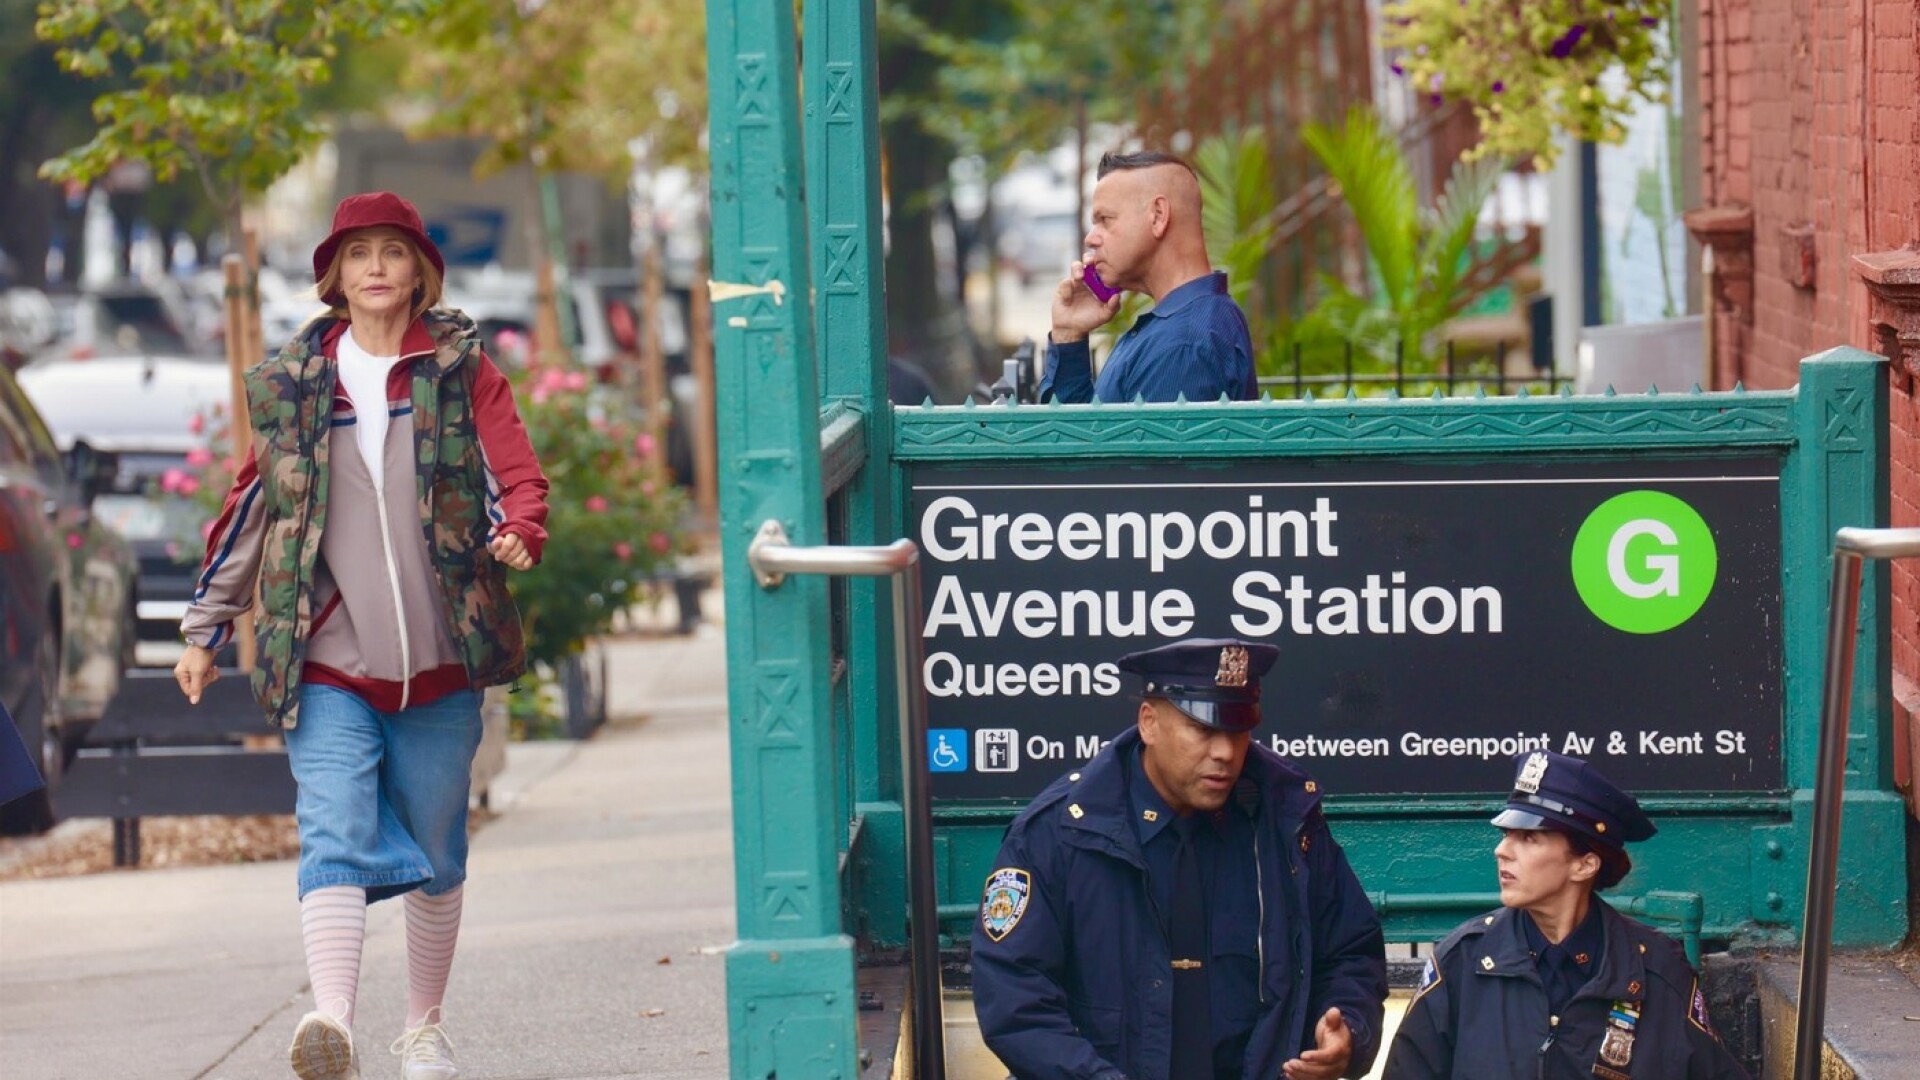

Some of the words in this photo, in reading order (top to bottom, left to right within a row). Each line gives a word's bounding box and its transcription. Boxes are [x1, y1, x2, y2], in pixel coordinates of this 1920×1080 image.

[920, 495, 1338, 573] Greenpoint
[1607, 518, 1680, 599] G
[923, 575, 1195, 639] Avenue
[1230, 570, 1503, 637] Station
[923, 651, 1121, 698] Queens
[1026, 735, 1065, 760] On
[1272, 733, 1390, 757] between
[1400, 731, 1550, 761] Greenpoint
[1561, 731, 1595, 755] Av
[1606, 731, 1627, 755] &
[1639, 731, 1704, 755] Kent
[1715, 729, 1746, 755] St
